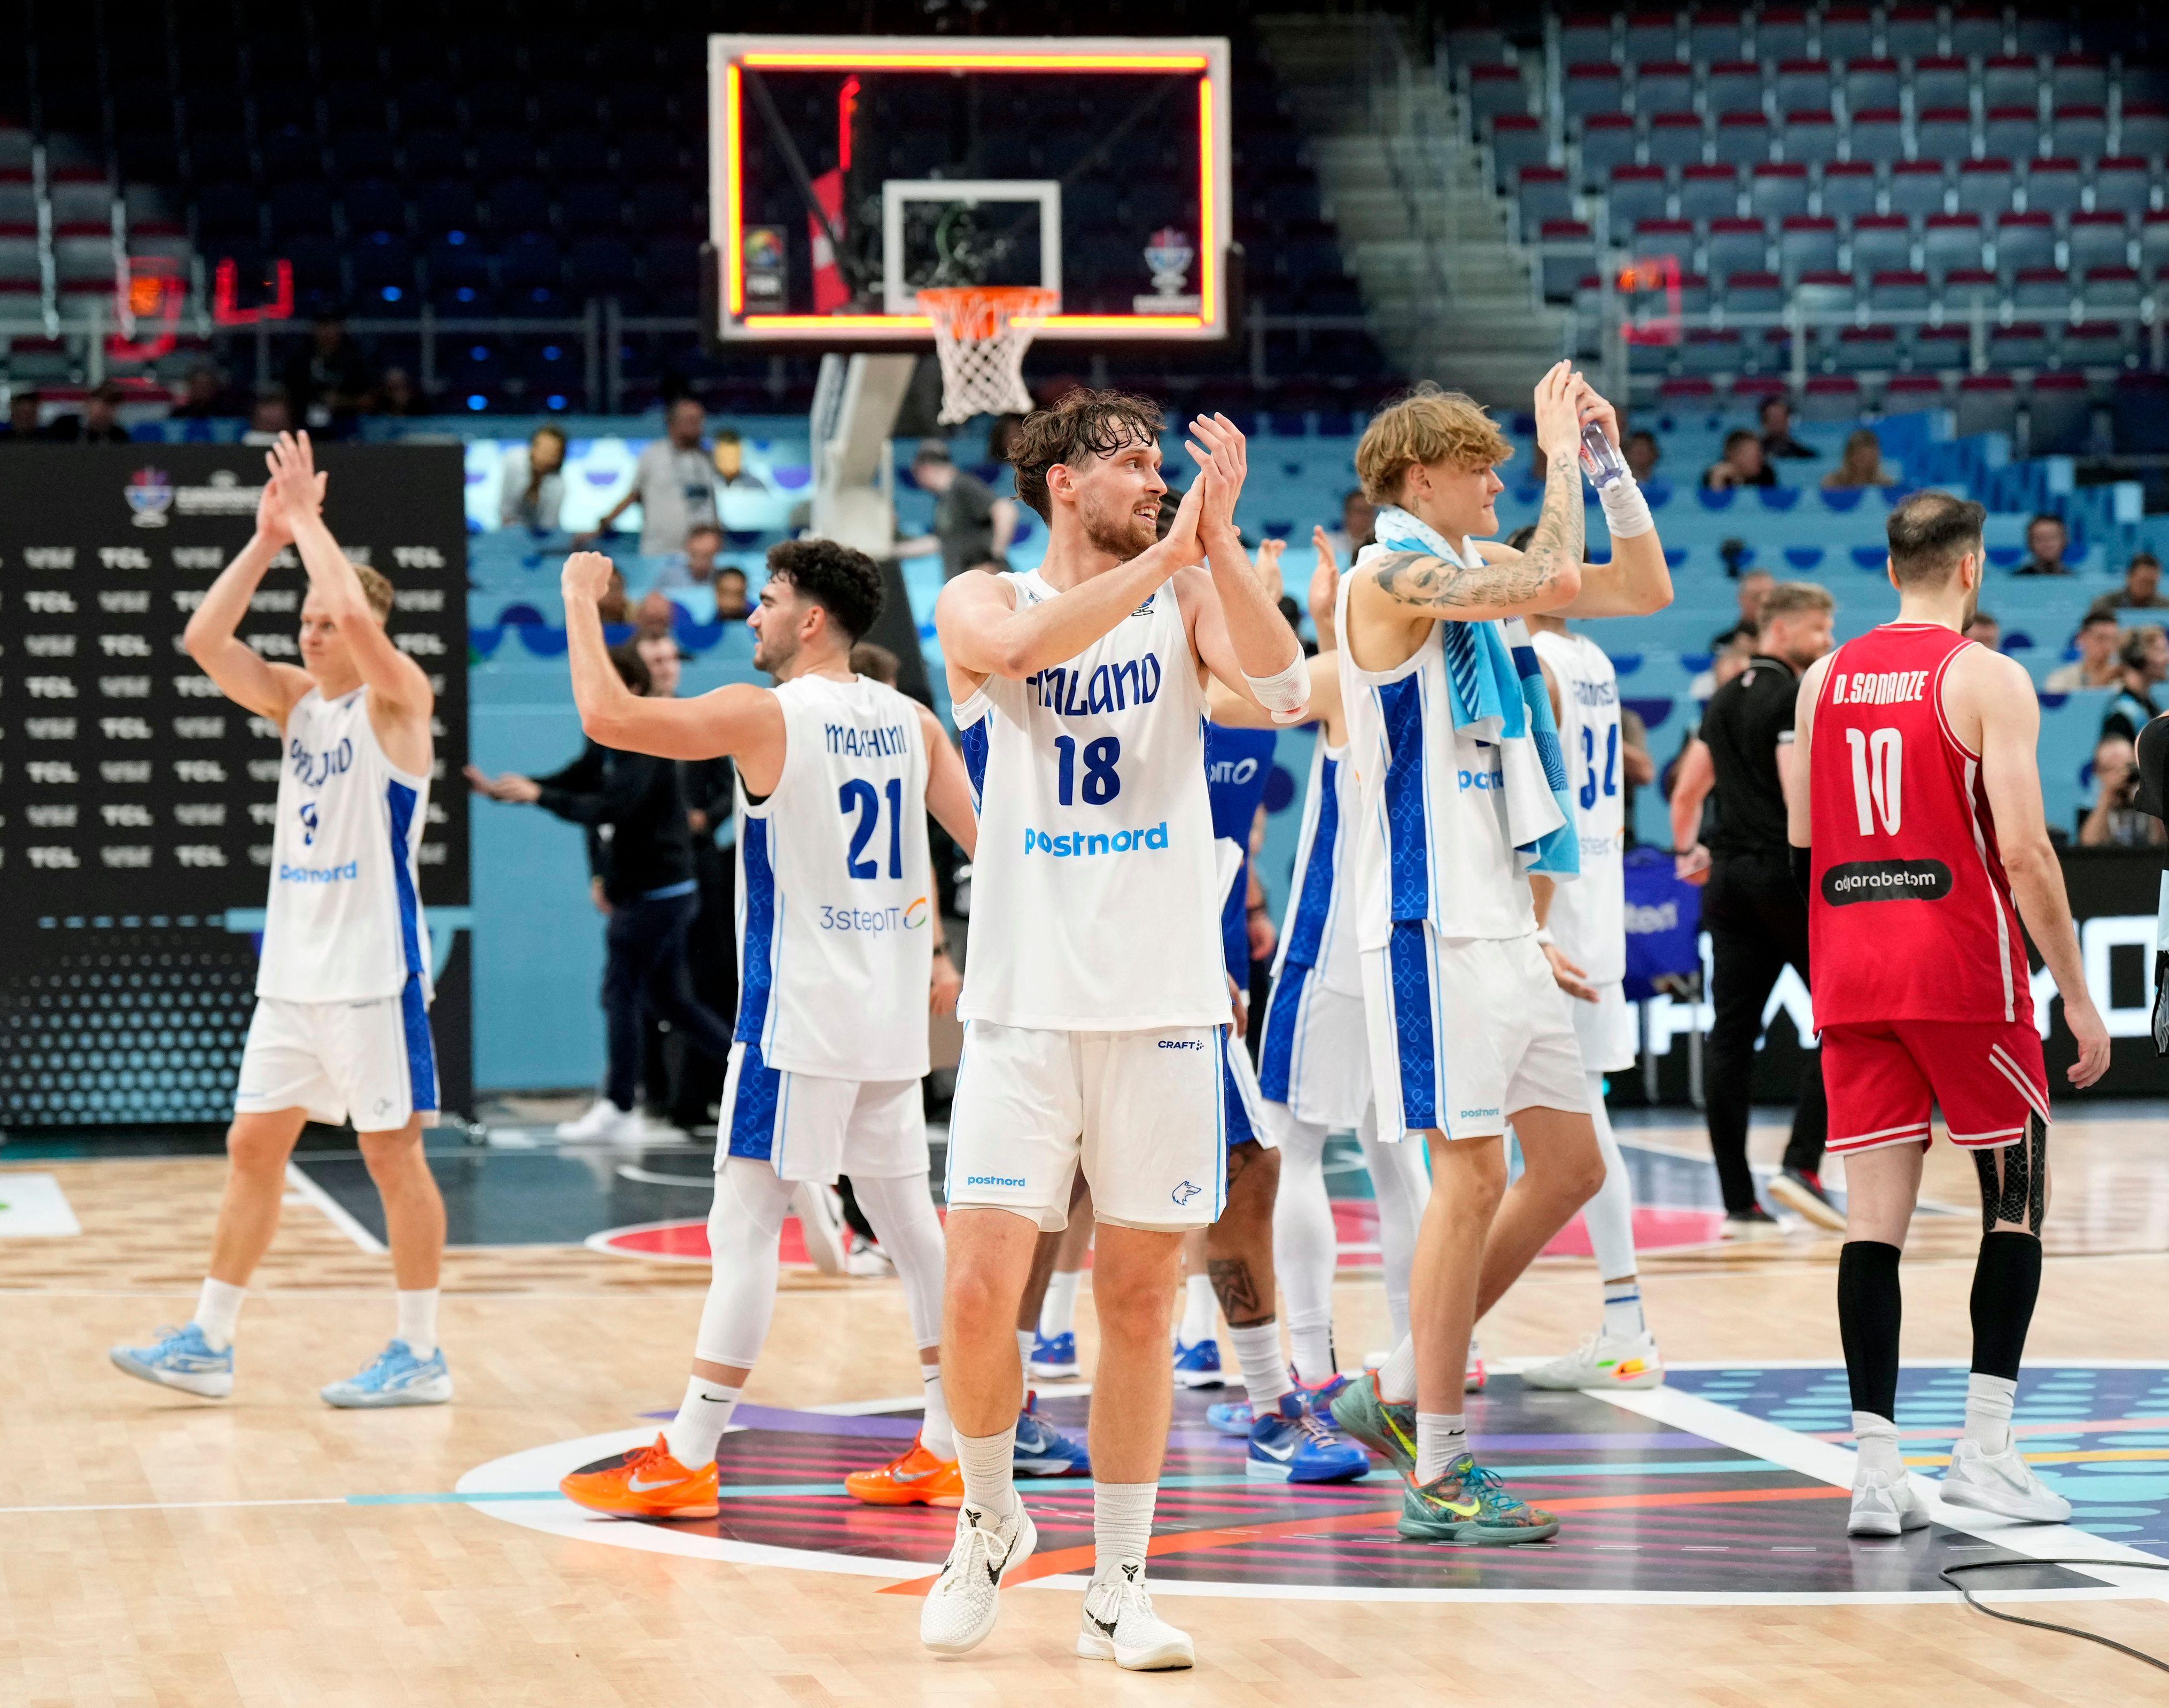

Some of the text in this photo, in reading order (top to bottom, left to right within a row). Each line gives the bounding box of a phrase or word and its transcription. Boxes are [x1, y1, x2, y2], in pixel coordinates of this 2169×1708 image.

[1054, 735, 1121, 806] 18
[1846, 727, 1903, 837] 10
[839, 778, 902, 879] 21
[1024, 822, 1169, 857] postnord
[820, 906, 900, 938] 3stepIT
[1157, 1040, 1195, 1050] CRAFT
[967, 1175, 1025, 1188] postnord
